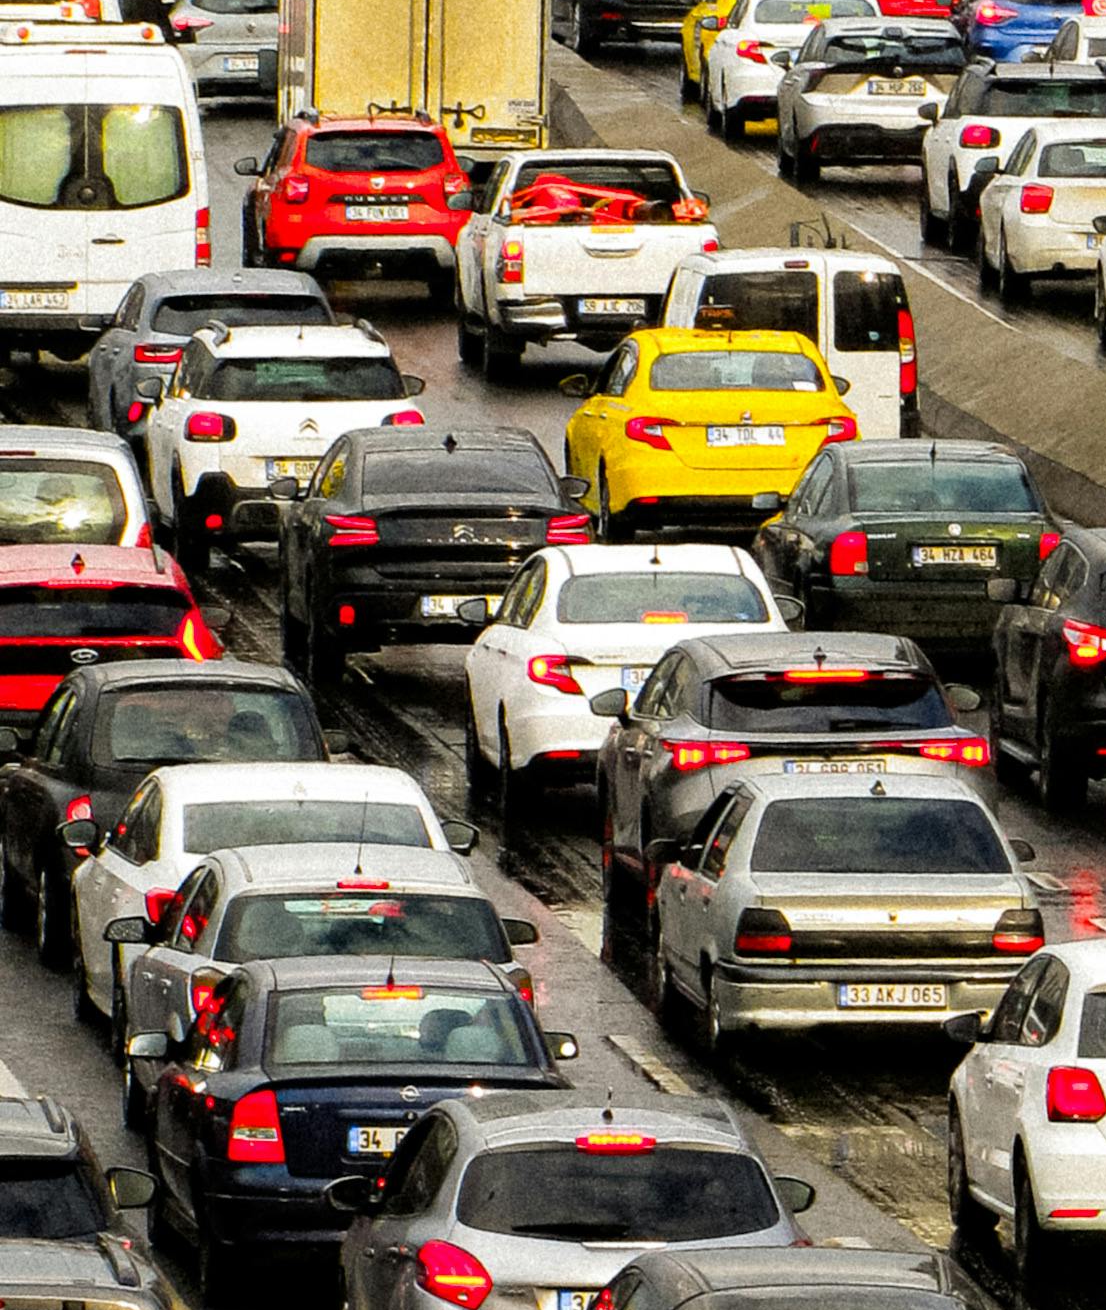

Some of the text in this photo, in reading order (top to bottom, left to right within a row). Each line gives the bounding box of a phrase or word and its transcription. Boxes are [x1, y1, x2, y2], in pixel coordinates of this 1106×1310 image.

[714, 427, 728, 441] 34
[768, 426, 782, 440] 44
[920, 548, 994, 561] 34 HZA 464
[430, 598, 445, 610] 34
[850, 987, 943, 1003] 33 AKJ 065
[359, 1129, 382, 1149] 34
